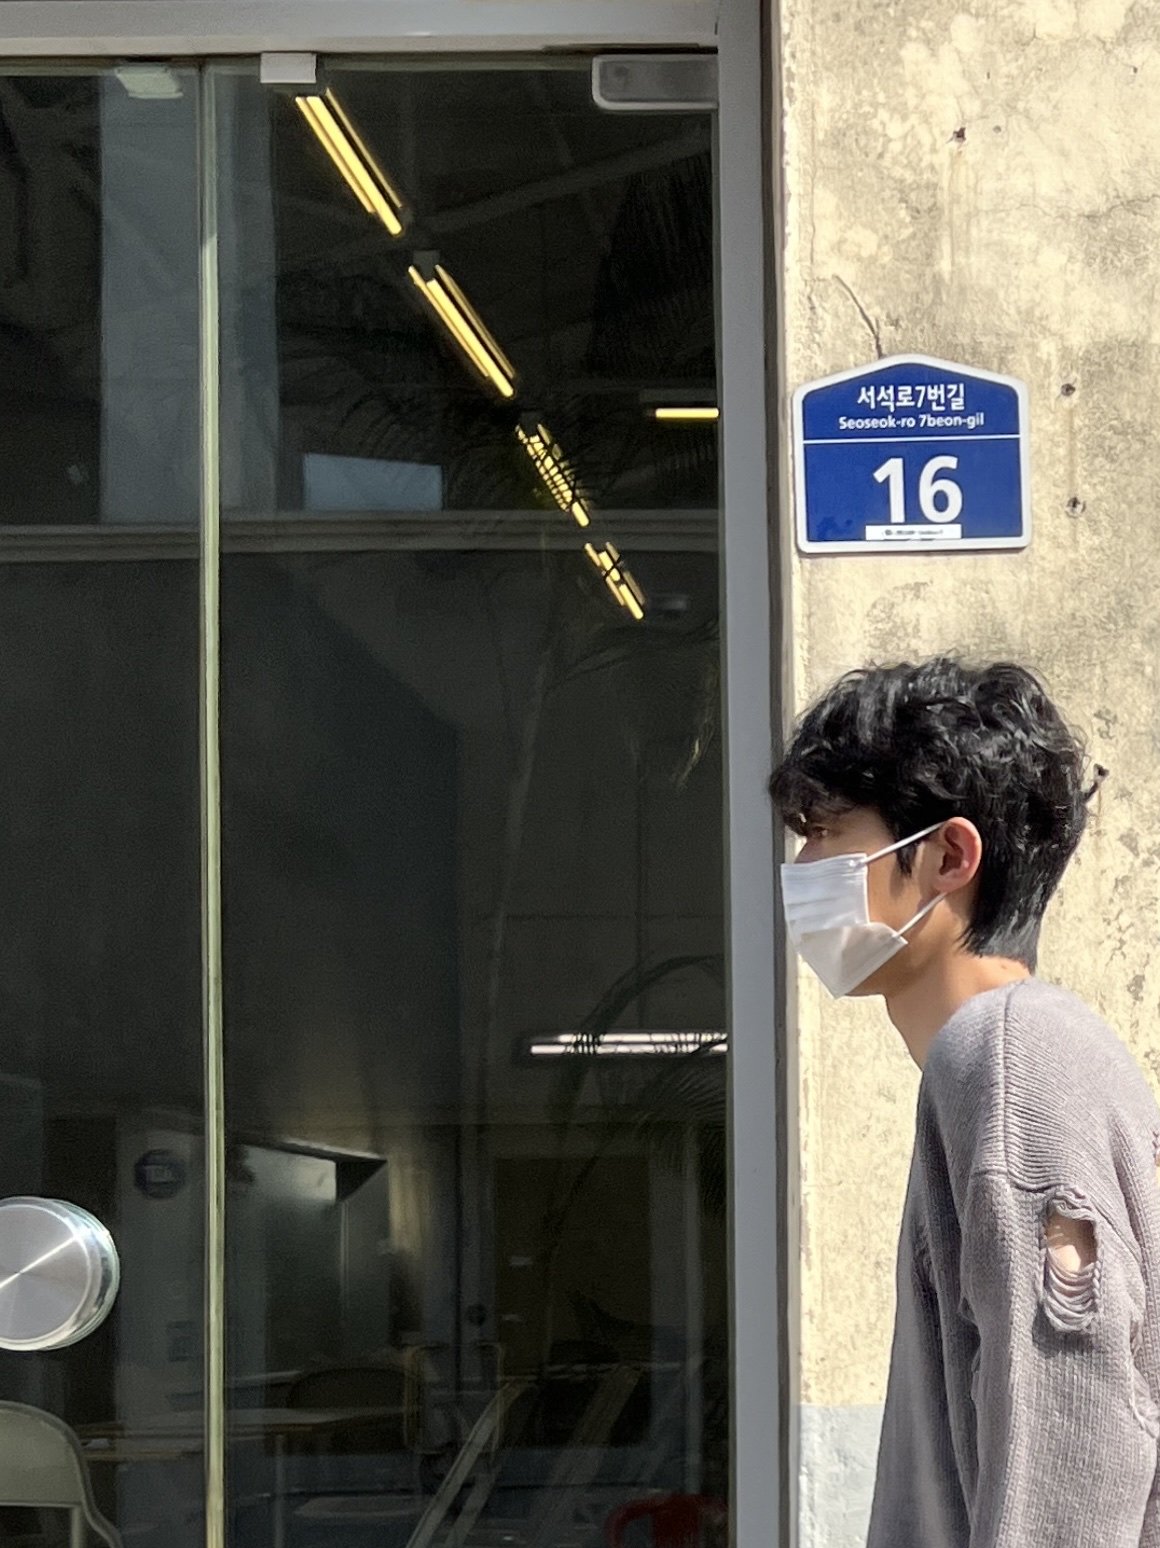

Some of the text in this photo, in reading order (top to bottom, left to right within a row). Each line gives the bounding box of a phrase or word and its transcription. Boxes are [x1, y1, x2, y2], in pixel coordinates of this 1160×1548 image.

[857, 383, 965, 412] 서석로7번길
[839, 412, 984, 430] Seoseok-ro 7beon-gil
[872, 455, 963, 523] 16
